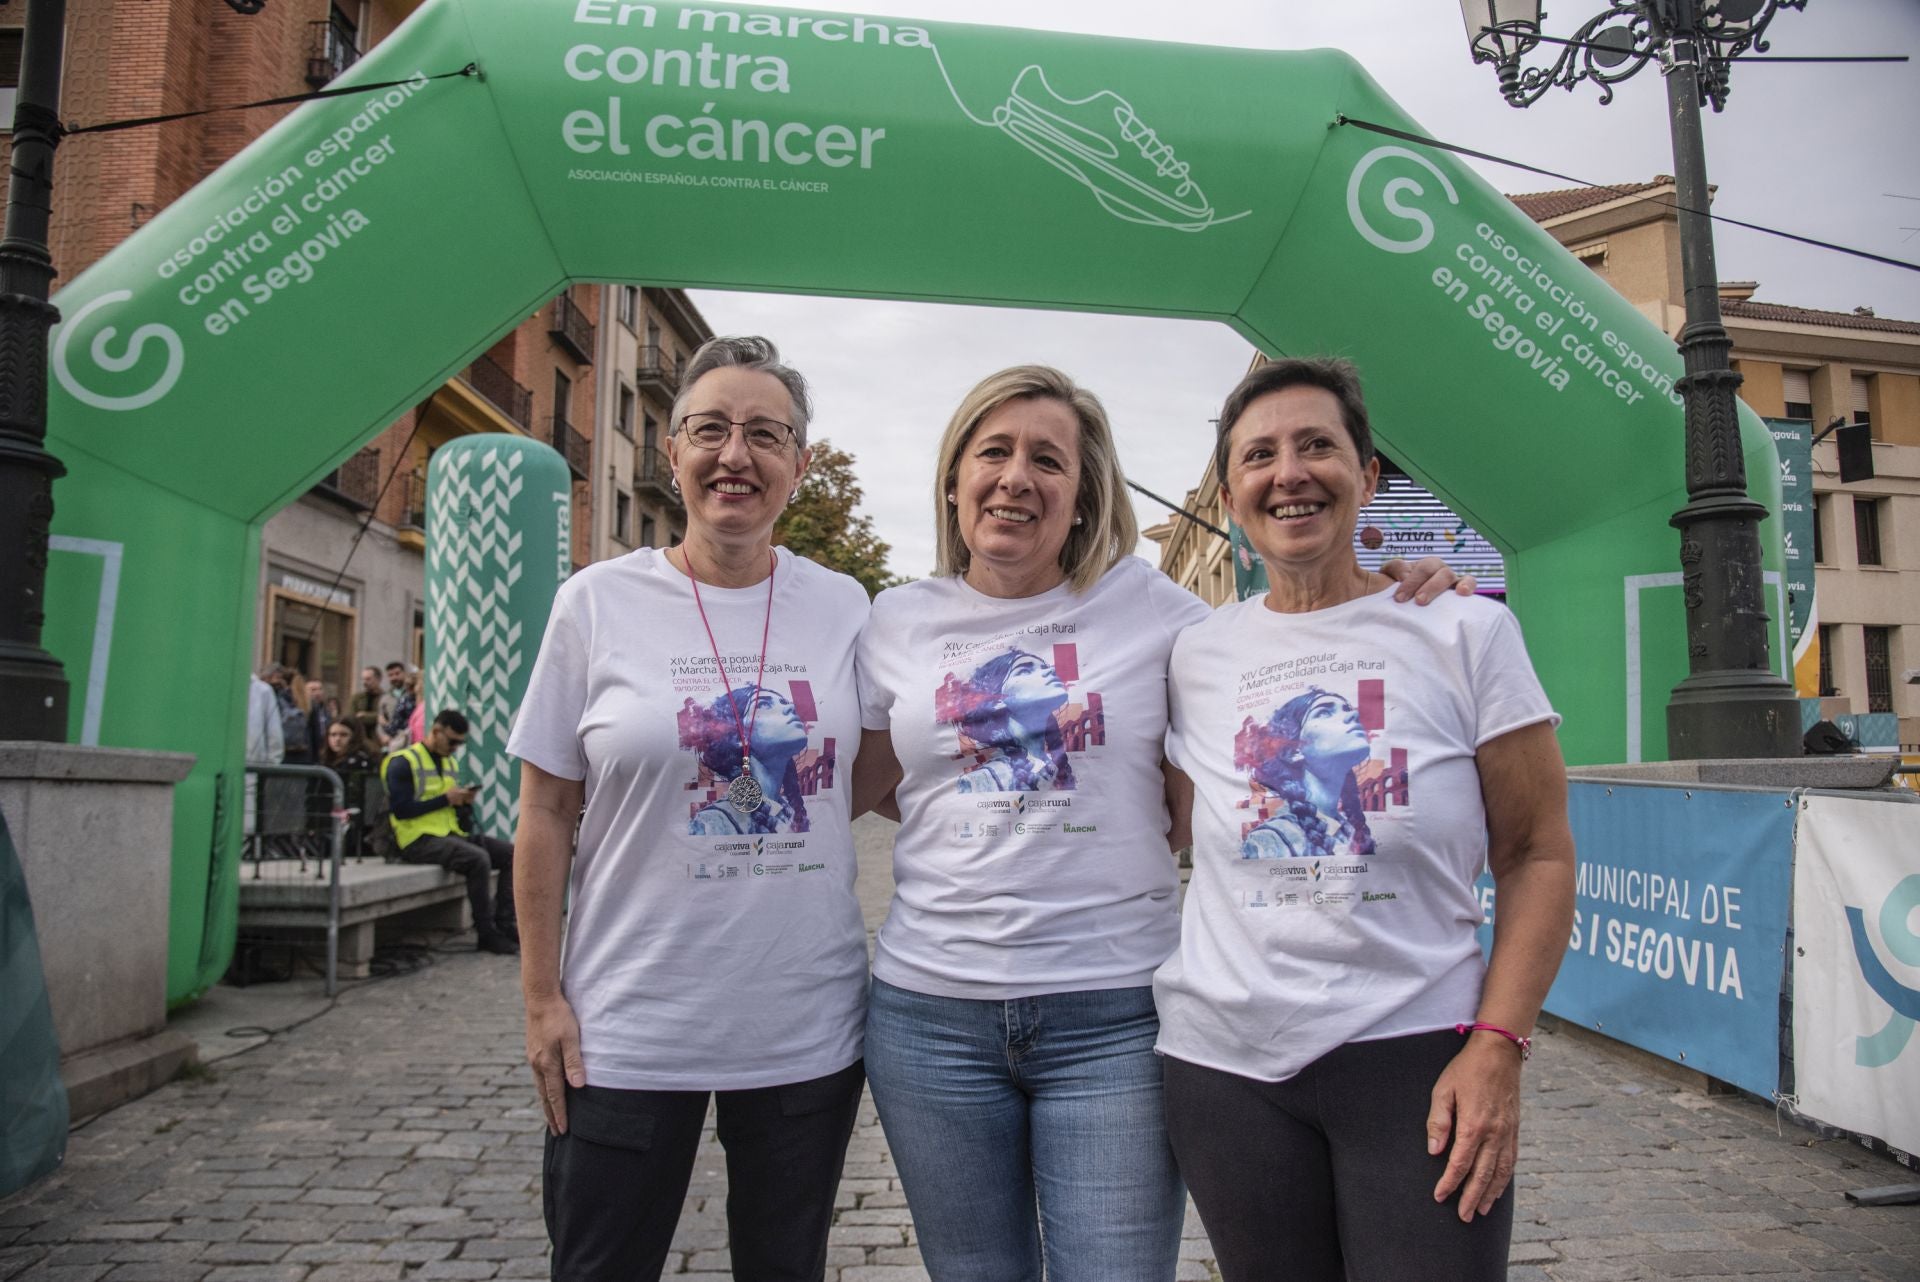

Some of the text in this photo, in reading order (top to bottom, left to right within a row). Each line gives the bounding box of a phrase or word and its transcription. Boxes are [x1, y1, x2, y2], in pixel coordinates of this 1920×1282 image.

[574, 0, 933, 49] En marcha
[563, 42, 791, 94] contra
[562, 96, 886, 169] el cáncer
[157, 69, 431, 280] asociación española
[568, 169, 829, 193] ASOCIACIÓN ESPAÑOLA CONTRA EL CÁNCER
[178, 133, 398, 306] contra el cáncer
[204, 205, 371, 336] en Segovia
[1431, 266, 1572, 393] en Segovia
[1456, 243, 1645, 407] contra el cáncer
[1476, 222, 1685, 407] asociación españo
[943, 641, 964, 652] XIV
[1027, 623, 1076, 636] Caja Rural
[670, 656, 688, 665] XIV
[680, 666, 717, 675] Marcha
[761, 664, 783, 675] Caja
[785, 664, 808, 673] Rural
[1240, 652, 1338, 682] XIV Carrera popular
[1246, 674, 1281, 691] Marcha
[1284, 664, 1327, 681] solidaria
[1329, 661, 1354, 674] Caja
[1357, 660, 1385, 670] Rural
[715, 840, 805, 853] cajaviva cajarural
[1269, 863, 1369, 877] cajaviva cajarural
[1576, 861, 1742, 930] MUNICIPAL DE
[1605, 918, 1744, 1001] SEGOVIA
